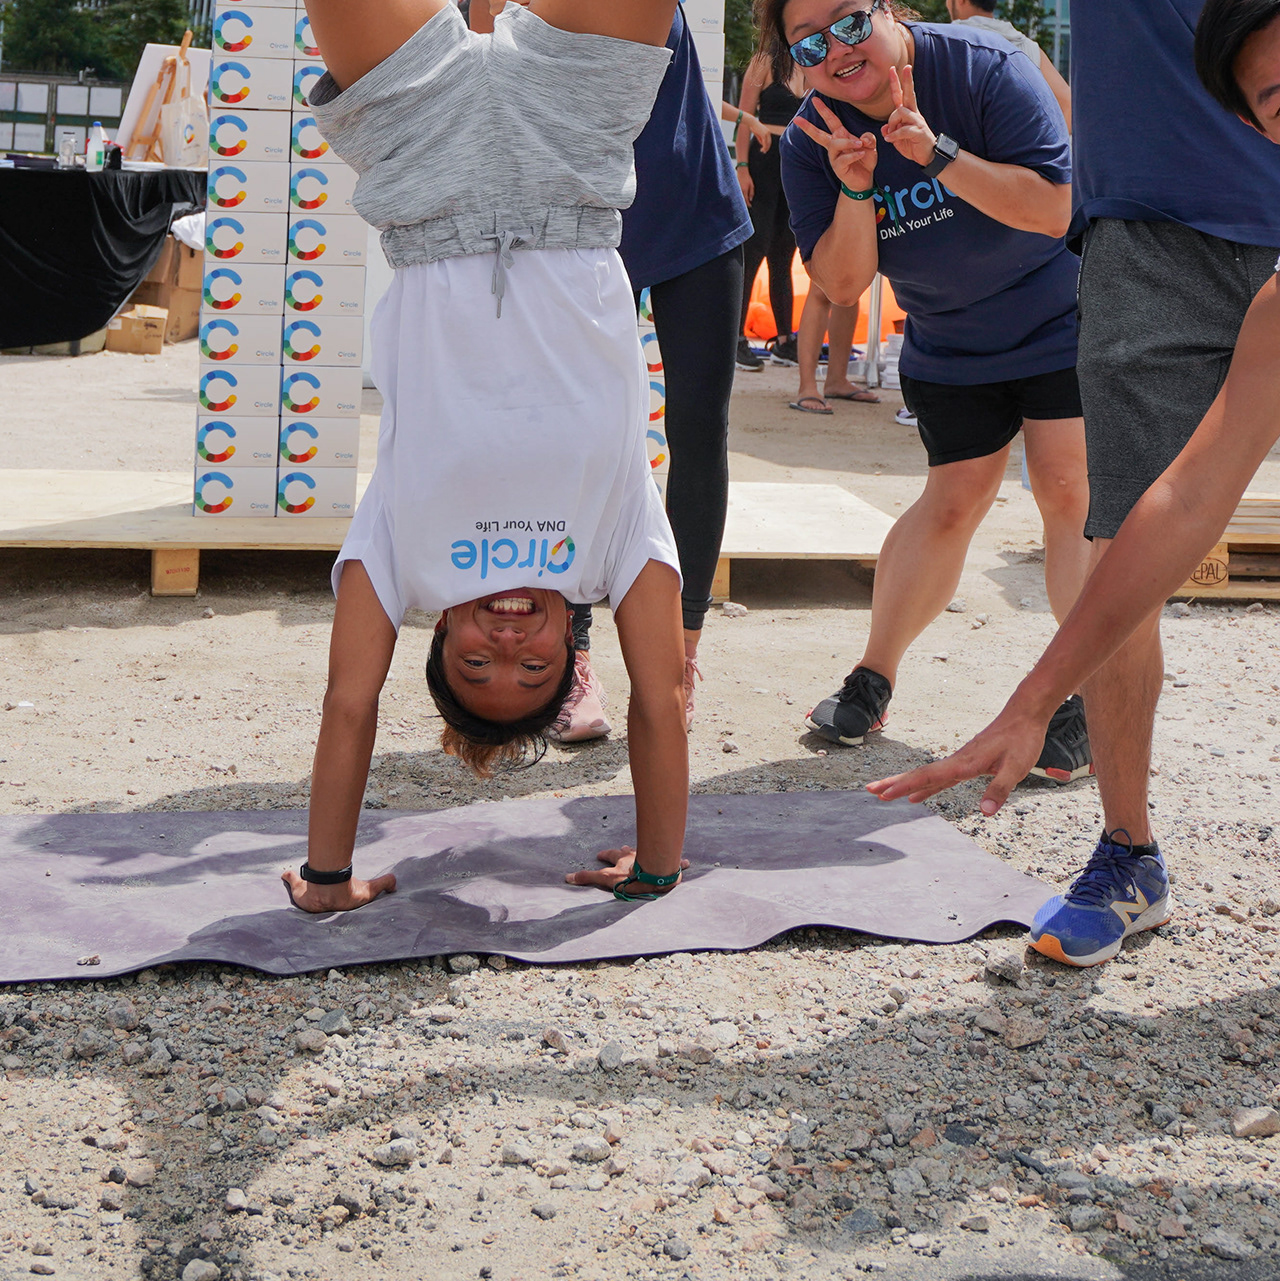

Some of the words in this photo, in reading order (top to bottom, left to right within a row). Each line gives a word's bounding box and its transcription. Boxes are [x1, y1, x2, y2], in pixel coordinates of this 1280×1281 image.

[880, 225, 906, 240] DNA
[906, 215, 932, 231] Your
[933, 207, 954, 222] Life
[475, 521, 499, 533] Life
[503, 520, 533, 532] Your
[536, 520, 566, 532] DNA
[451, 535, 576, 580] Circle
